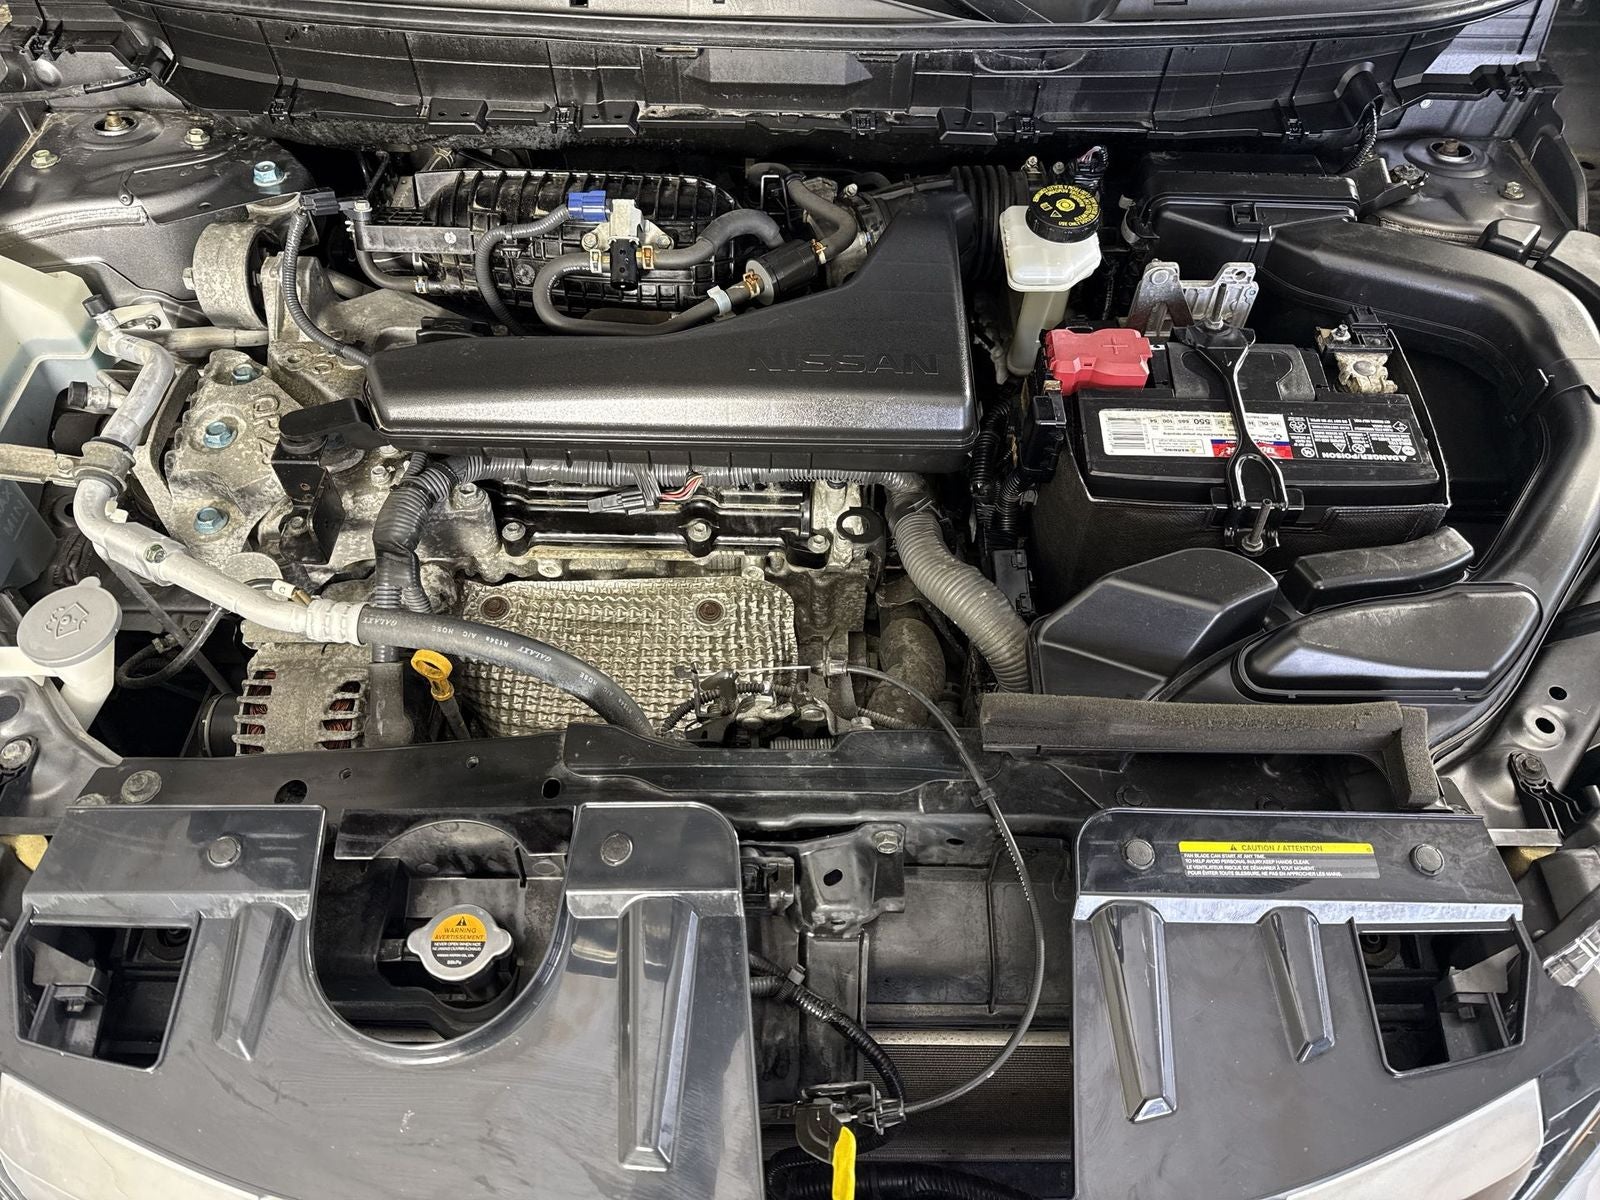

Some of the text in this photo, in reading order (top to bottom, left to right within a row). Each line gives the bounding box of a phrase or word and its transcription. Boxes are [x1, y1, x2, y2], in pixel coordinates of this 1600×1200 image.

[748, 352, 939, 375] NISSAN
[361, 616, 398, 626] GALAXY
[462, 630, 477, 639] A/C
[486, 636, 509, 648] R134a
[517, 646, 552, 662] GALAXY
[580, 672, 598, 686] HOSE
